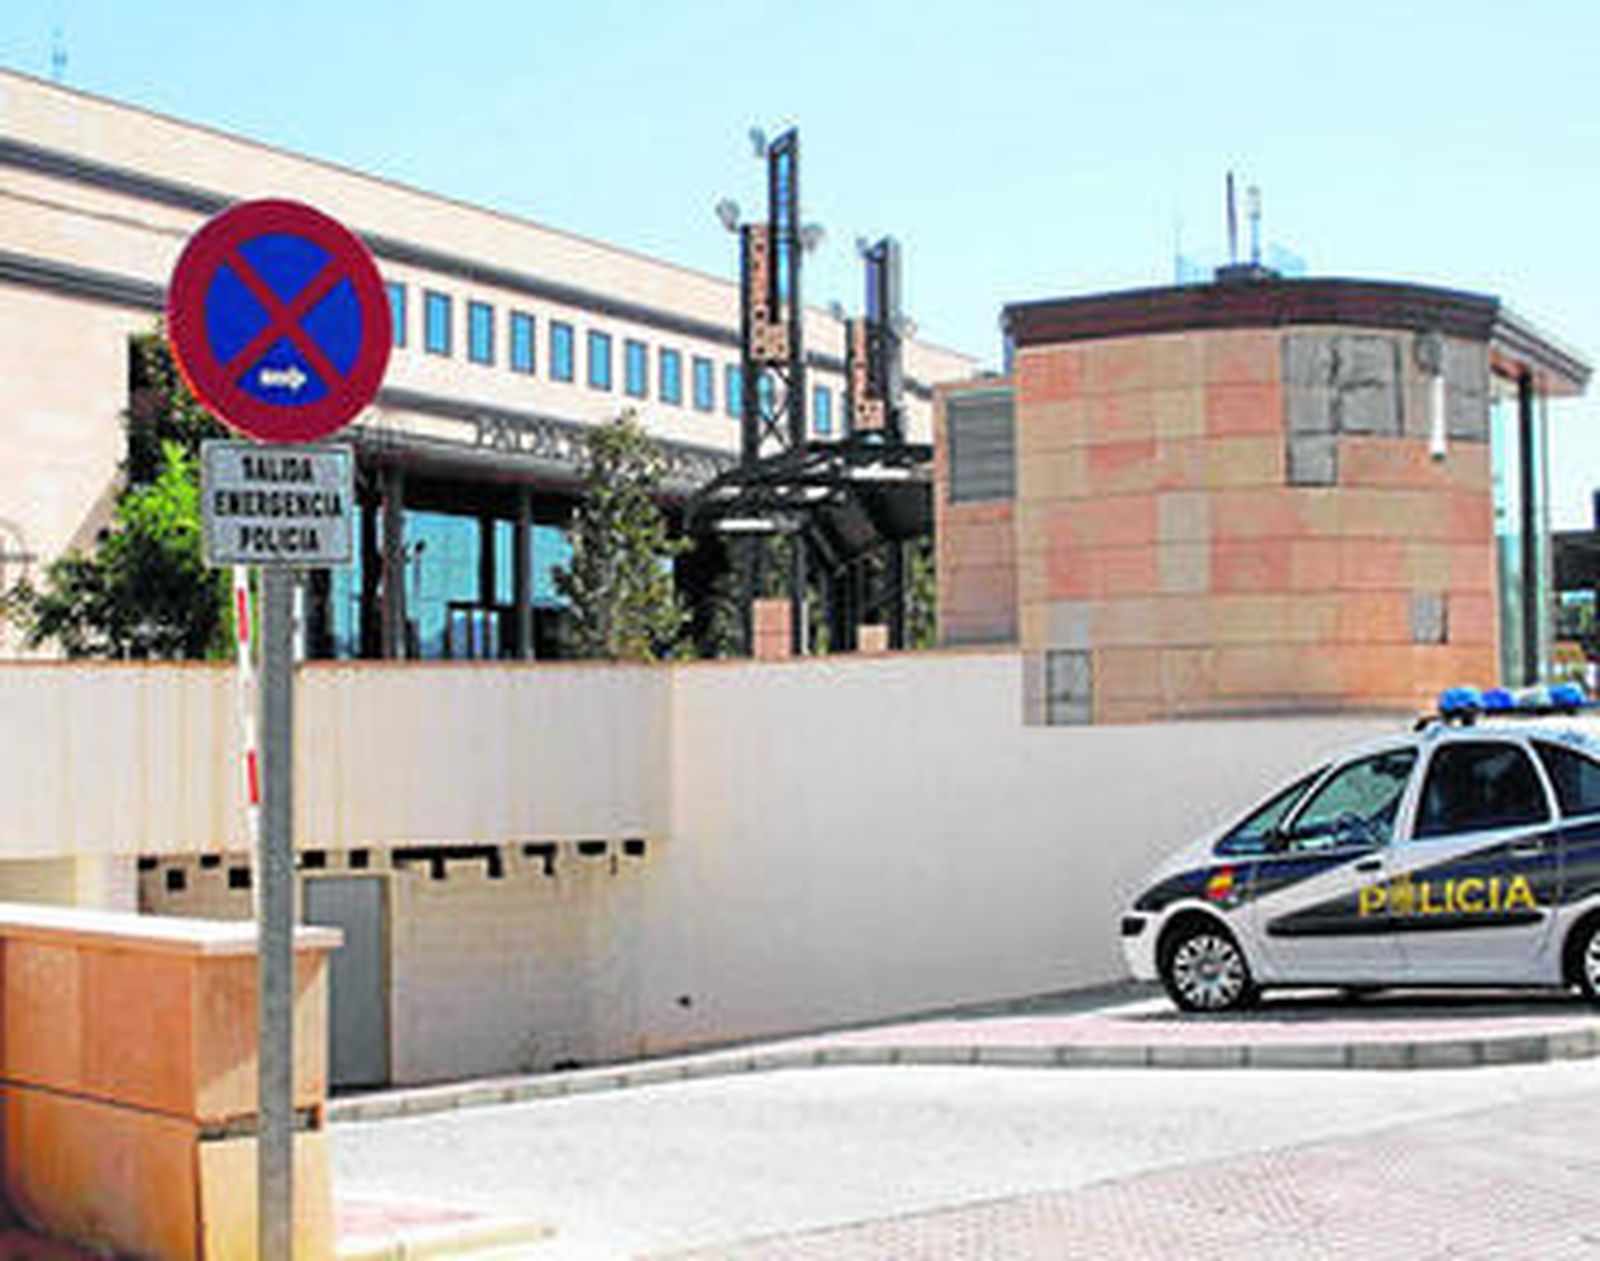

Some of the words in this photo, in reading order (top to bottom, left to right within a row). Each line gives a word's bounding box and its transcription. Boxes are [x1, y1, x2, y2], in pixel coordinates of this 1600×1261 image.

[242, 456, 314, 483] SALIDA
[214, 489, 343, 517] EMERGENCIA
[239, 526, 319, 552] POLICIA
[1359, 874, 1537, 917] POLICIA
